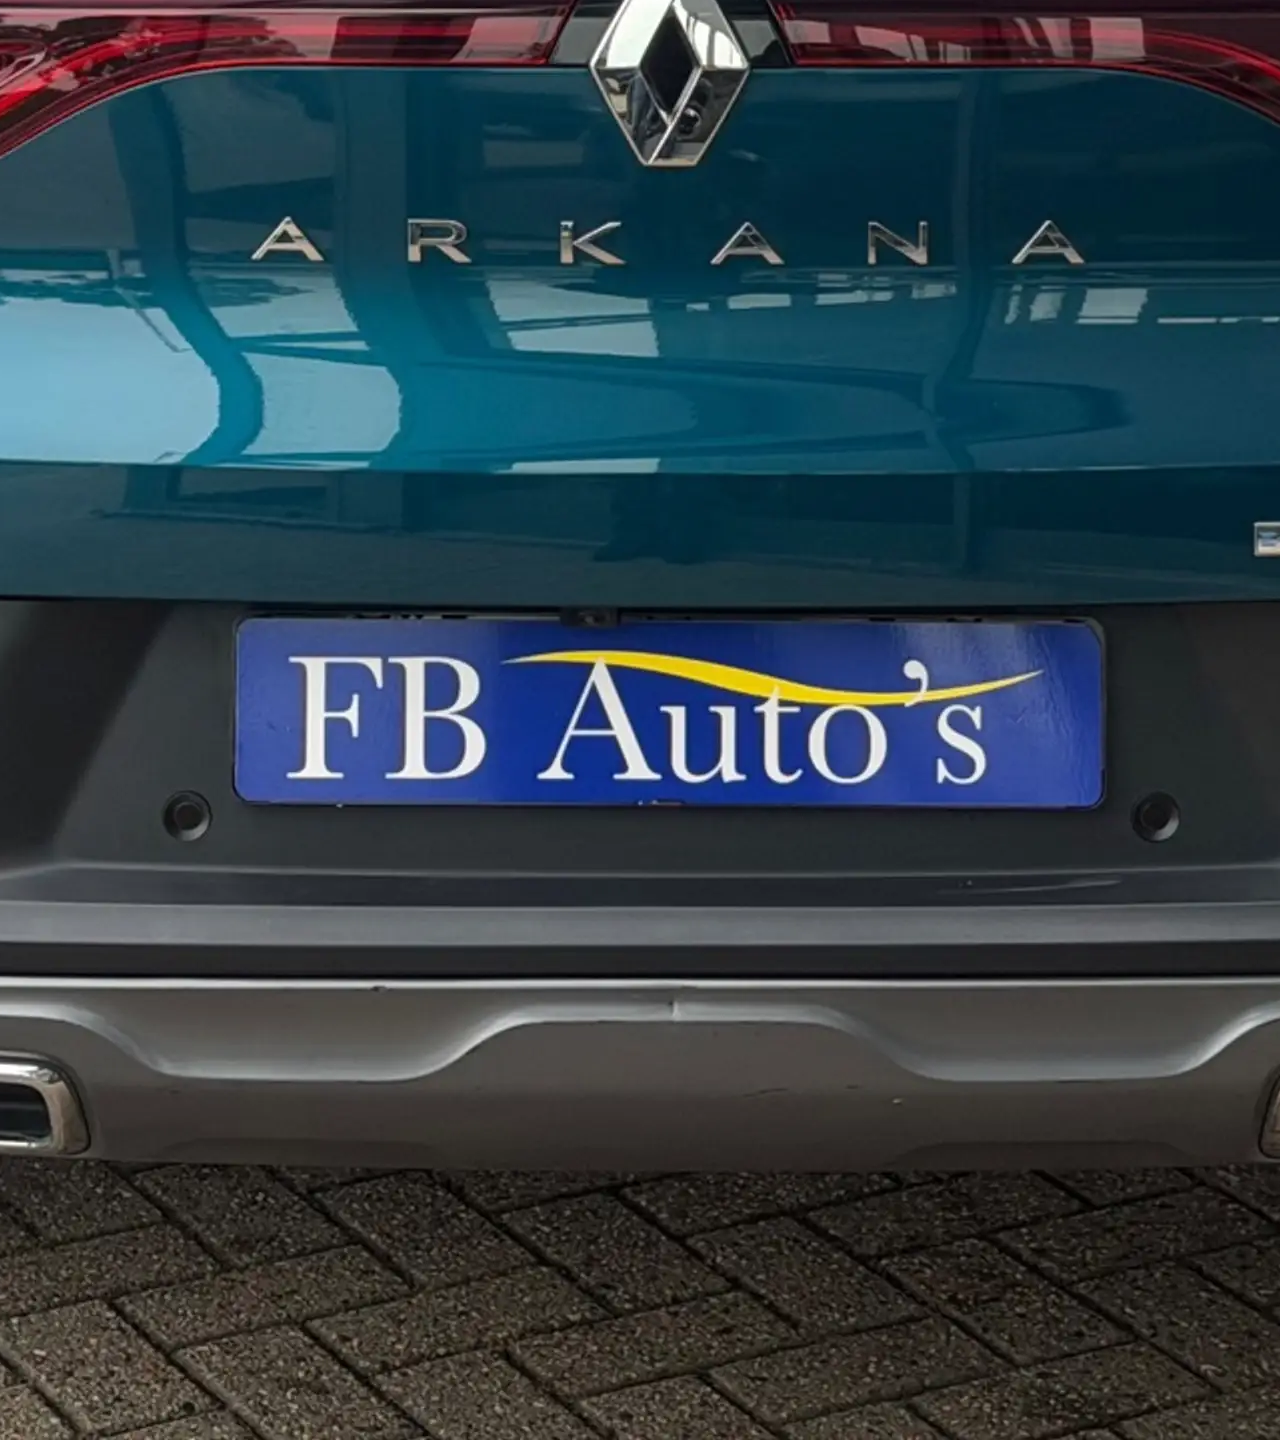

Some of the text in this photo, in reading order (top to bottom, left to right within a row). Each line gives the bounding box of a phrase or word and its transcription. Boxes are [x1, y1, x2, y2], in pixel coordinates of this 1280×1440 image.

[250, 215, 1086, 266] ARKANA
[286, 655, 987, 786] FB Auto's
